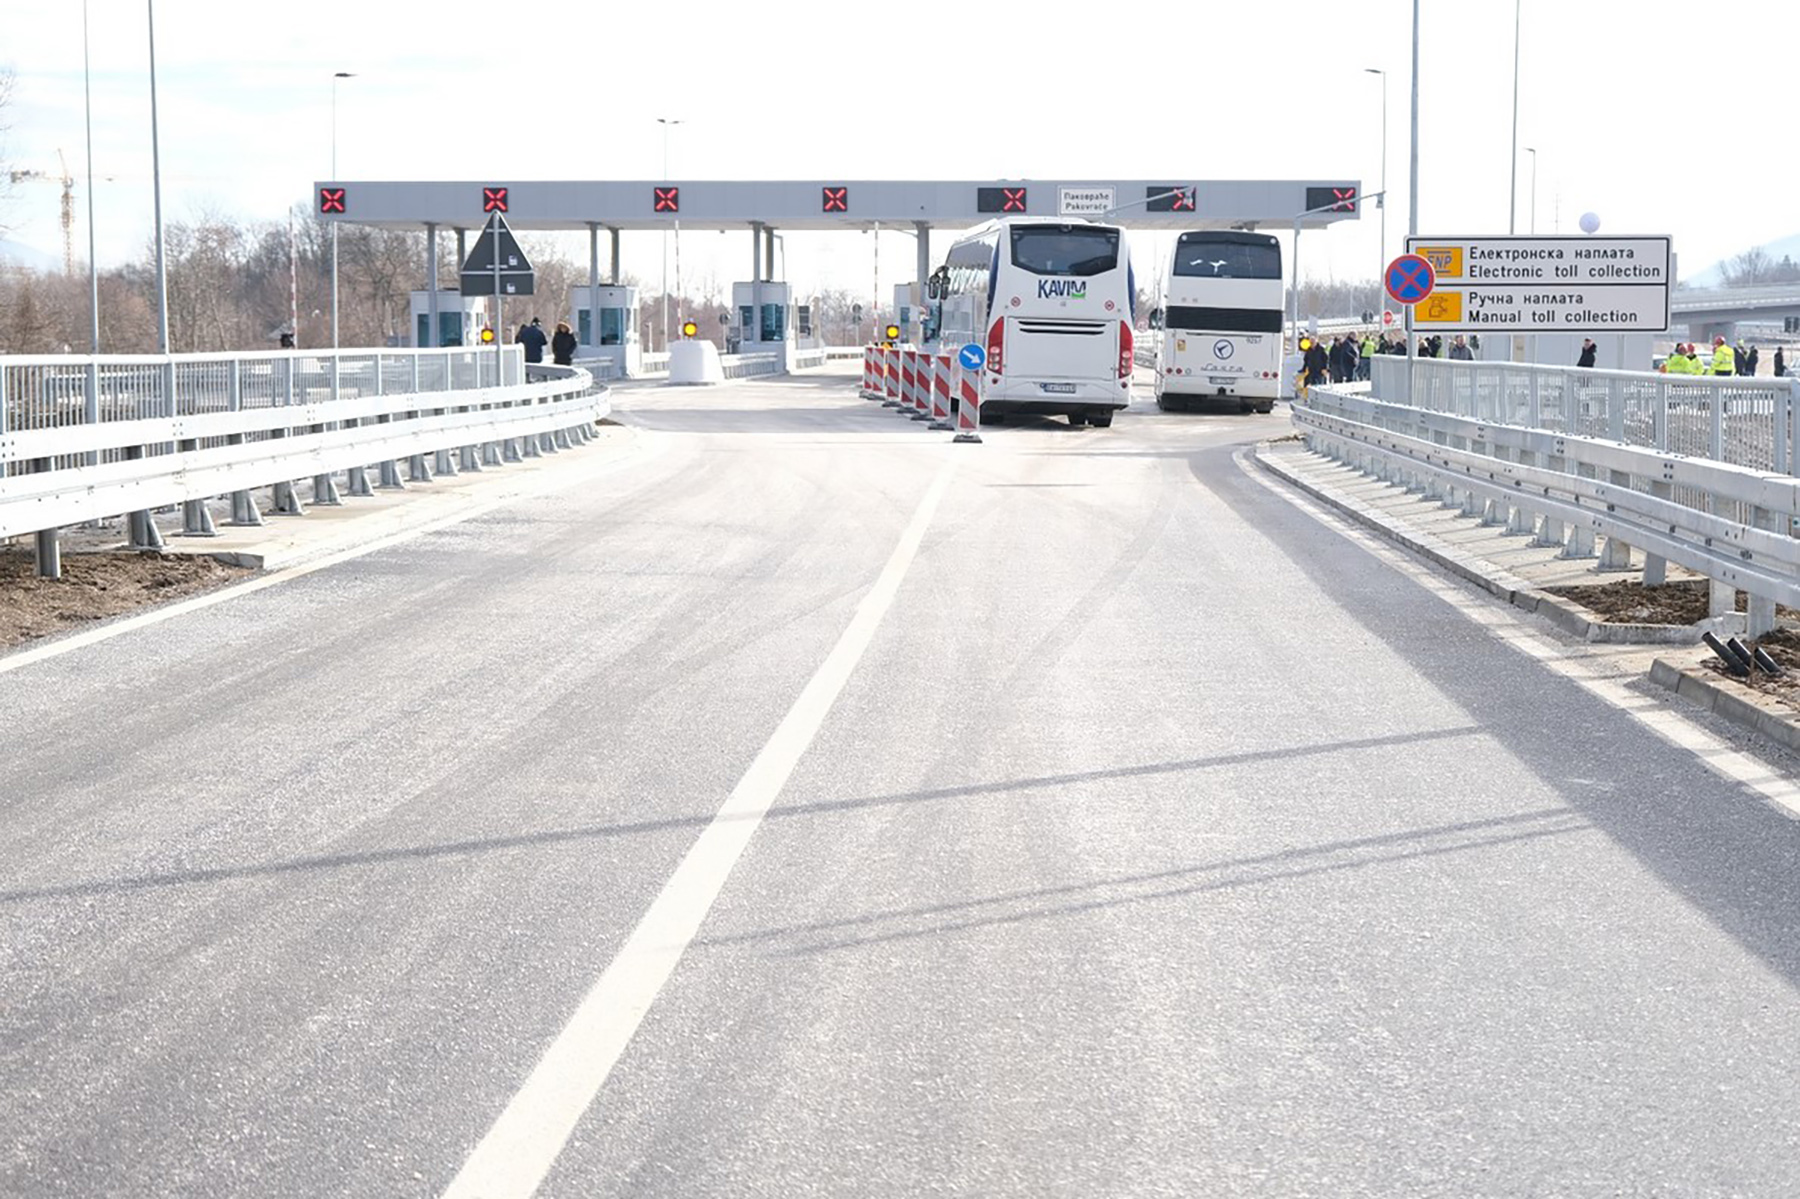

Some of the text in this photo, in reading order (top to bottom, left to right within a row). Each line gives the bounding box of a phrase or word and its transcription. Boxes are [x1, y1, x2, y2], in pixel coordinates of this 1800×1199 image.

[1469, 246, 1634, 262] Електронска наплата
[1469, 264, 1660, 278] Electronic toll collection
[1038, 279, 1086, 299] KAVIM
[1468, 291, 1584, 308] Ручна наплата
[1468, 310, 1638, 323] Manual toll collection
